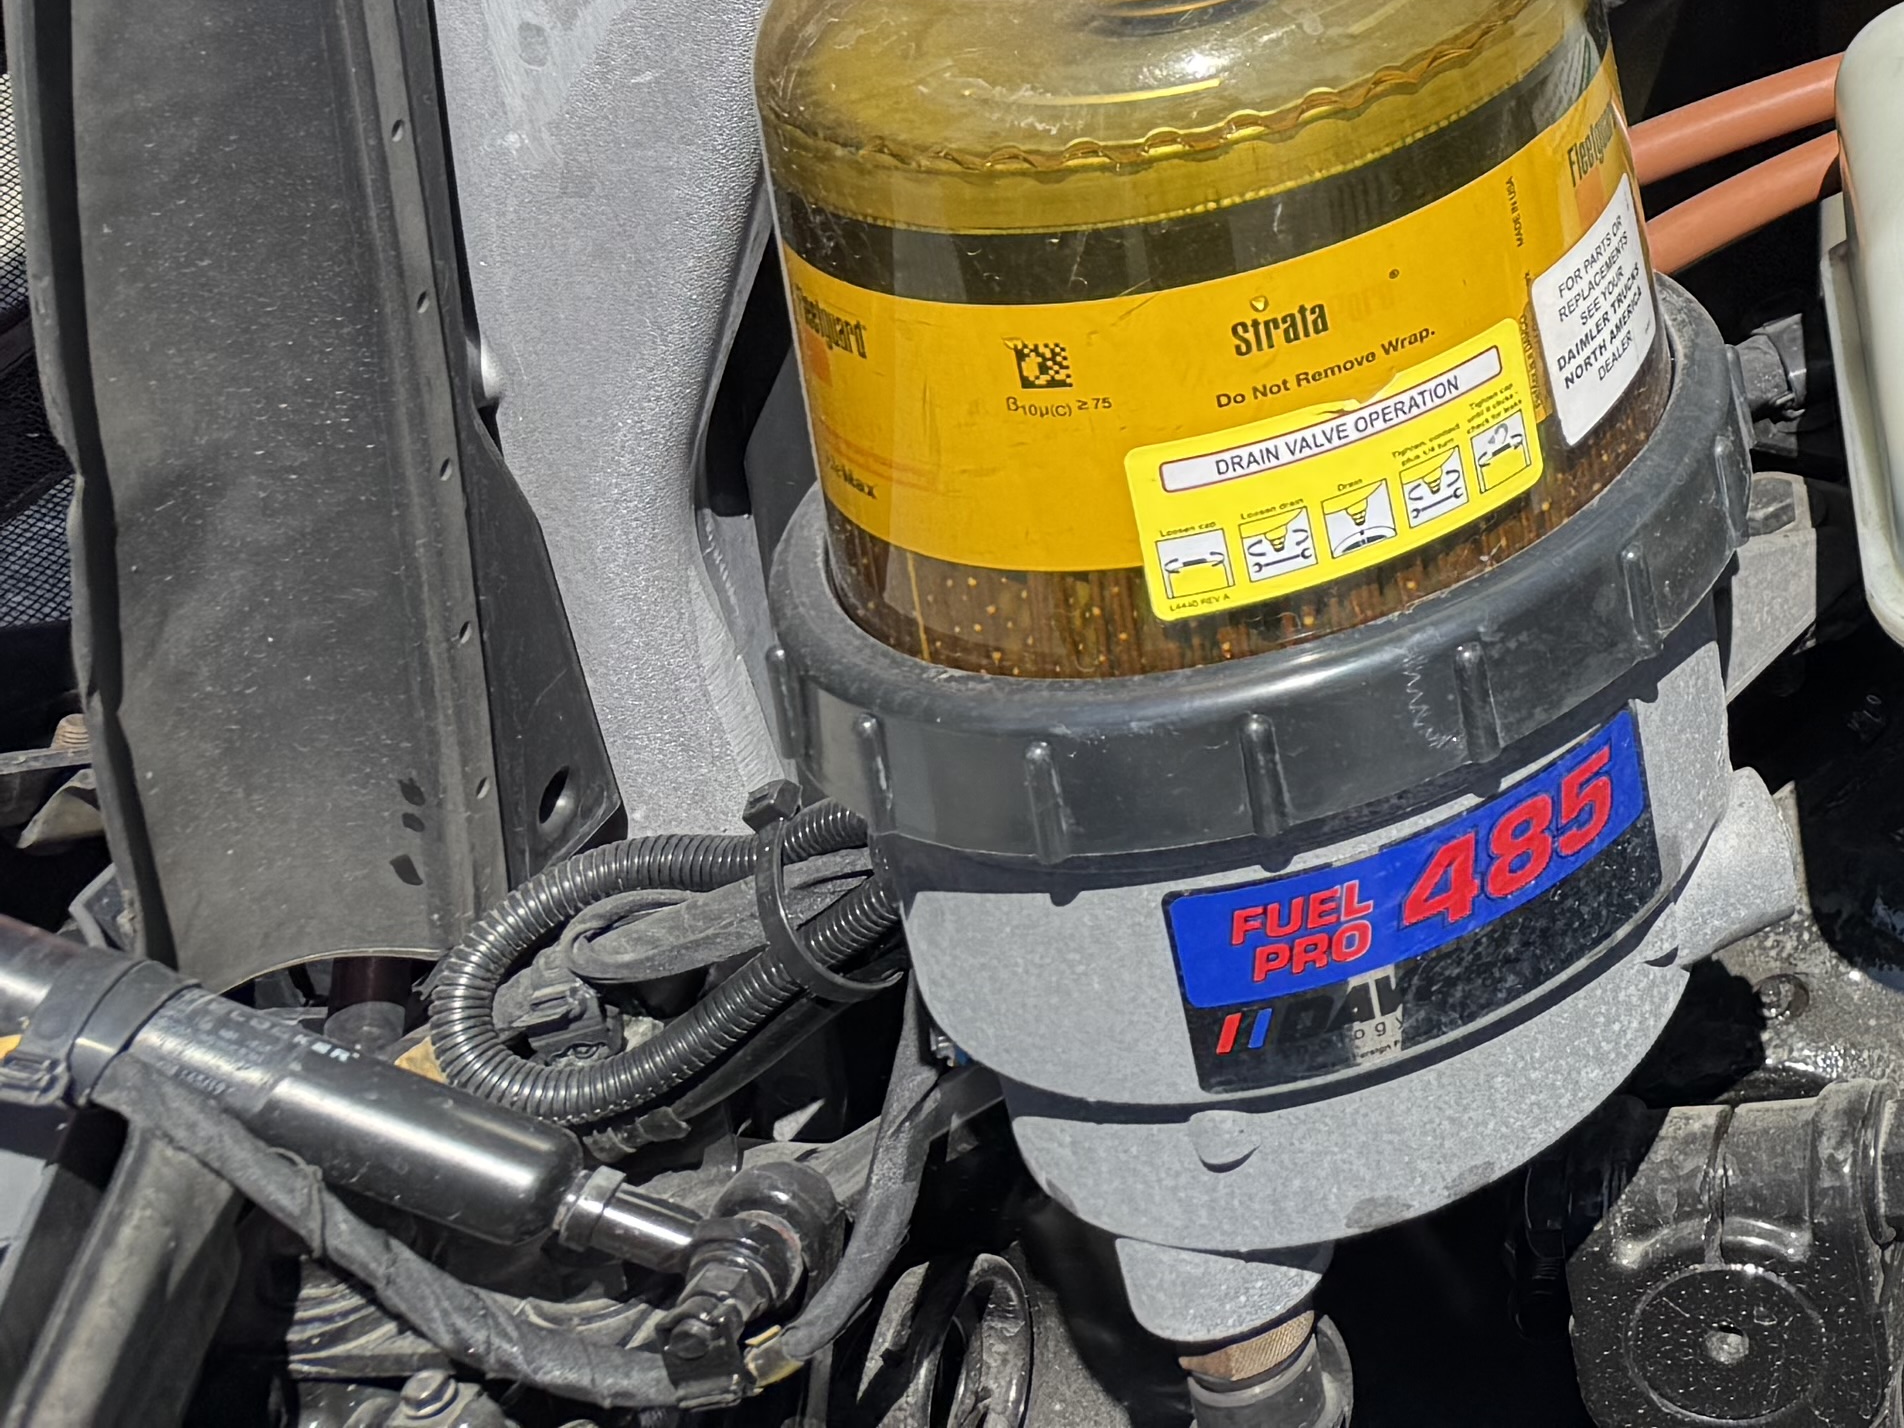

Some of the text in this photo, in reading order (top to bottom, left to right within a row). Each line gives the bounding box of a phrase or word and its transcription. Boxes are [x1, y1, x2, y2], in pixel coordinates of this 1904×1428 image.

[1557, 268, 1582, 298] FOR
[1582, 234, 1614, 274] PARTS
[1558, 231, 1629, 323] REPLACEMENTS
[1580, 265, 1624, 327] SEE YOUR
[1230, 302, 1330, 358] Strata
[1556, 261, 1641, 373] DAIMLER TRUCKS
[1563, 289, 1643, 389] NORTH AMERICA
[1216, 327, 1436, 409] Do Not Remove Wrap.
[1597, 329, 1633, 381] DEALER
[1092, 397, 1113, 410] 75
[1215, 374, 1460, 477] DRAIN VALVE OPERATION
[1240, 504, 1277, 520] Loosen
[1337, 478, 1363, 492] Drain
[1201, 595, 1221, 607] REV
[1221, 593, 1231, 602] A
[1230, 745, 1616, 946] FUEL 485
[1252, 919, 1374, 984] PRO
